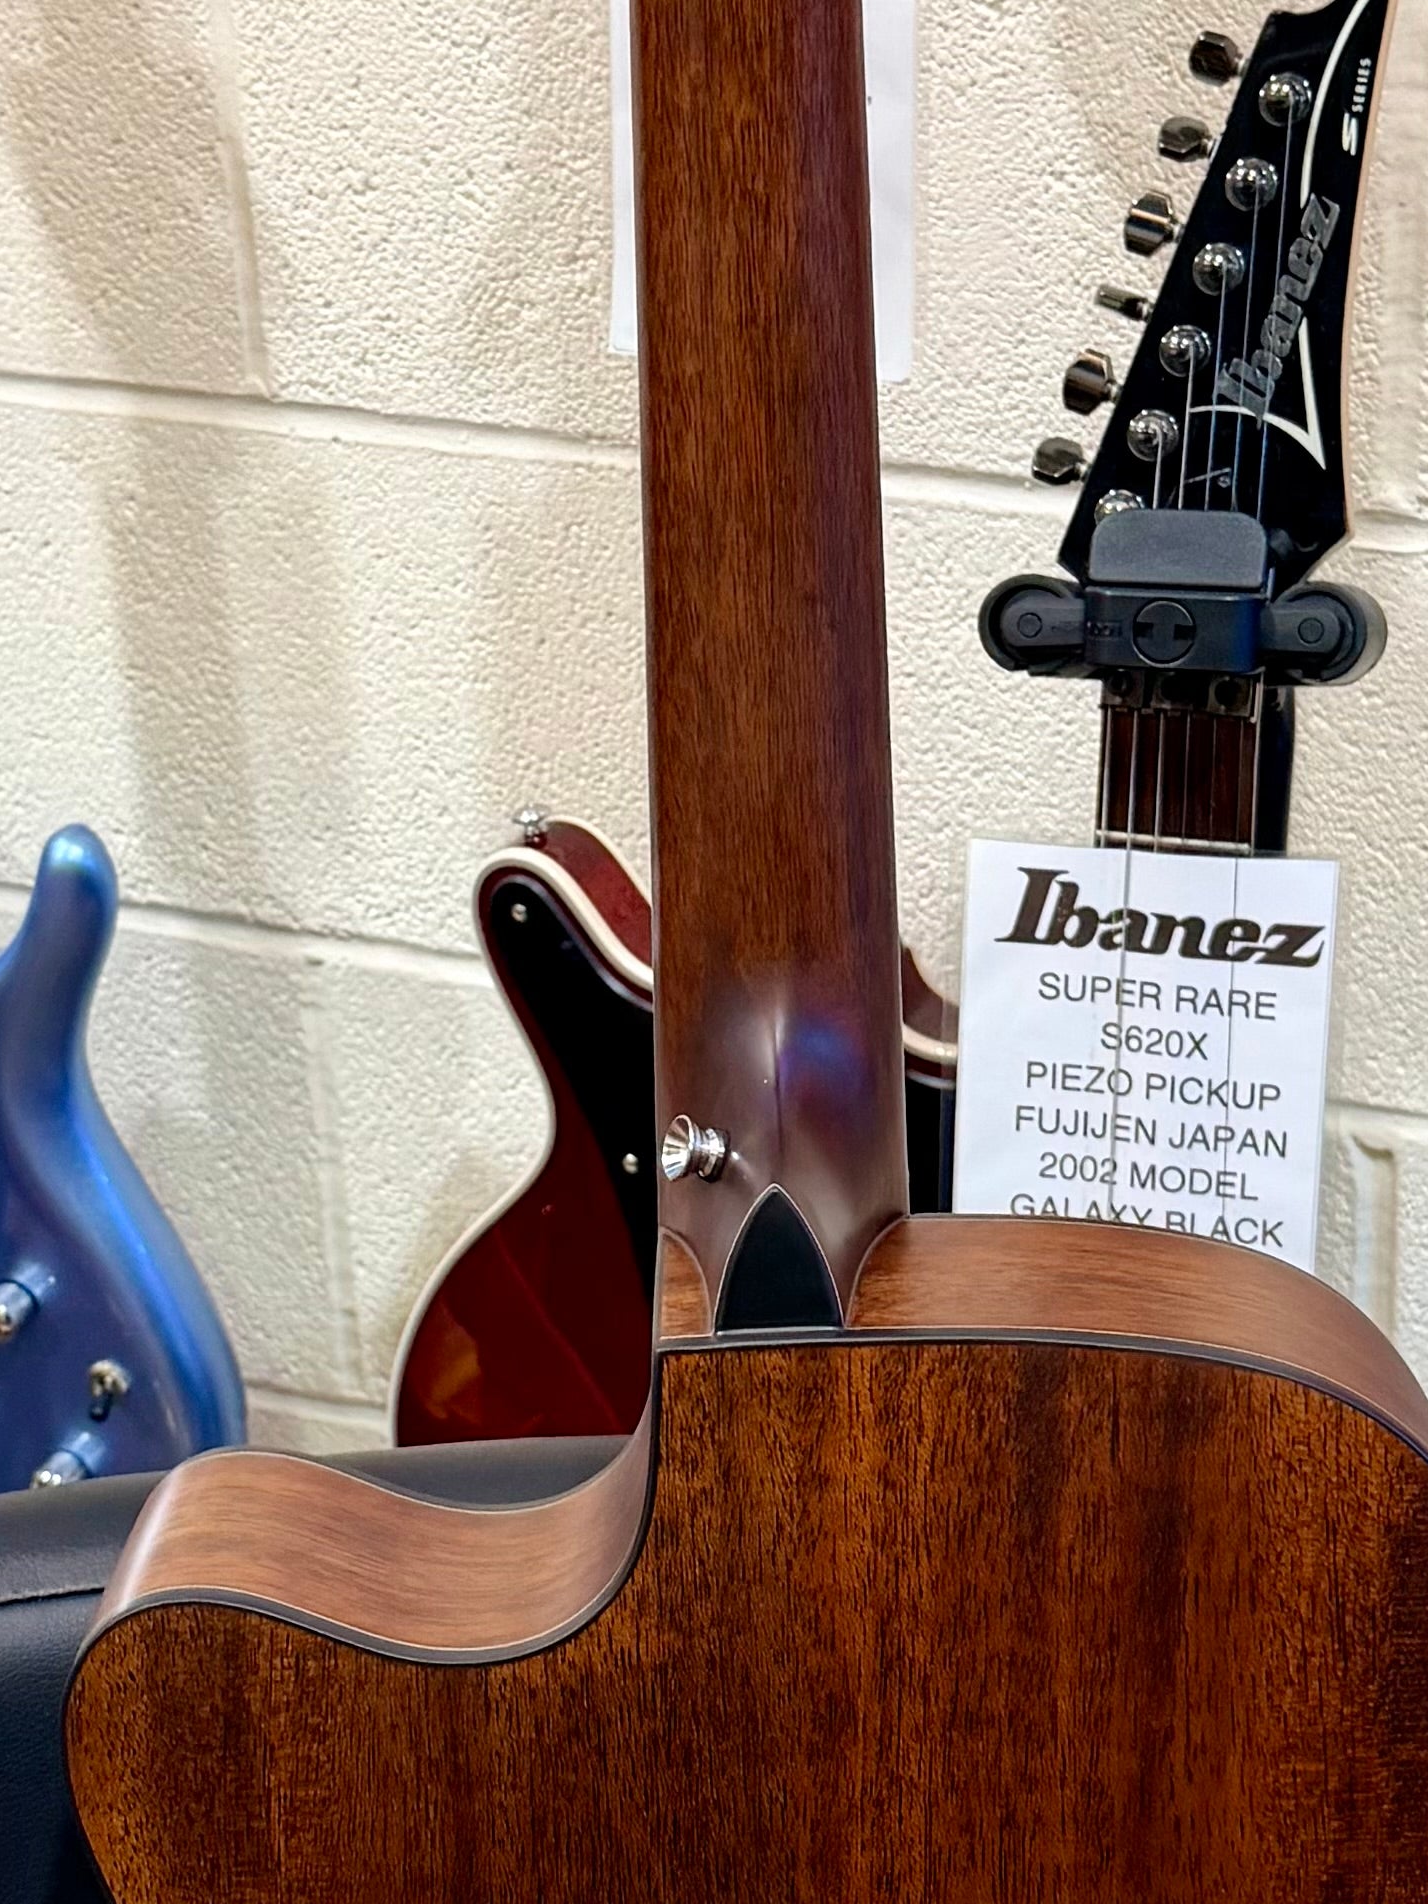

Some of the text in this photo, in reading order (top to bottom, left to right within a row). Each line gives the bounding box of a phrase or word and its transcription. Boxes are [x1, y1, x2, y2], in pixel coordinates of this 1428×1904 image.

[1351, 57, 1372, 113] SERIES
[1214, 193, 1340, 429] Ibanez
[995, 866, 1326, 968] Ibanez
[1038, 972, 1277, 1021] SUPER RARE
[1100, 1021, 1209, 1061] S620X
[1026, 1061, 1281, 1112] PIEZO PICKUP
[1015, 1105, 1287, 1158] FUJIJEN JAPAN
[1039, 1152, 1259, 1201] 2002 MODEL
